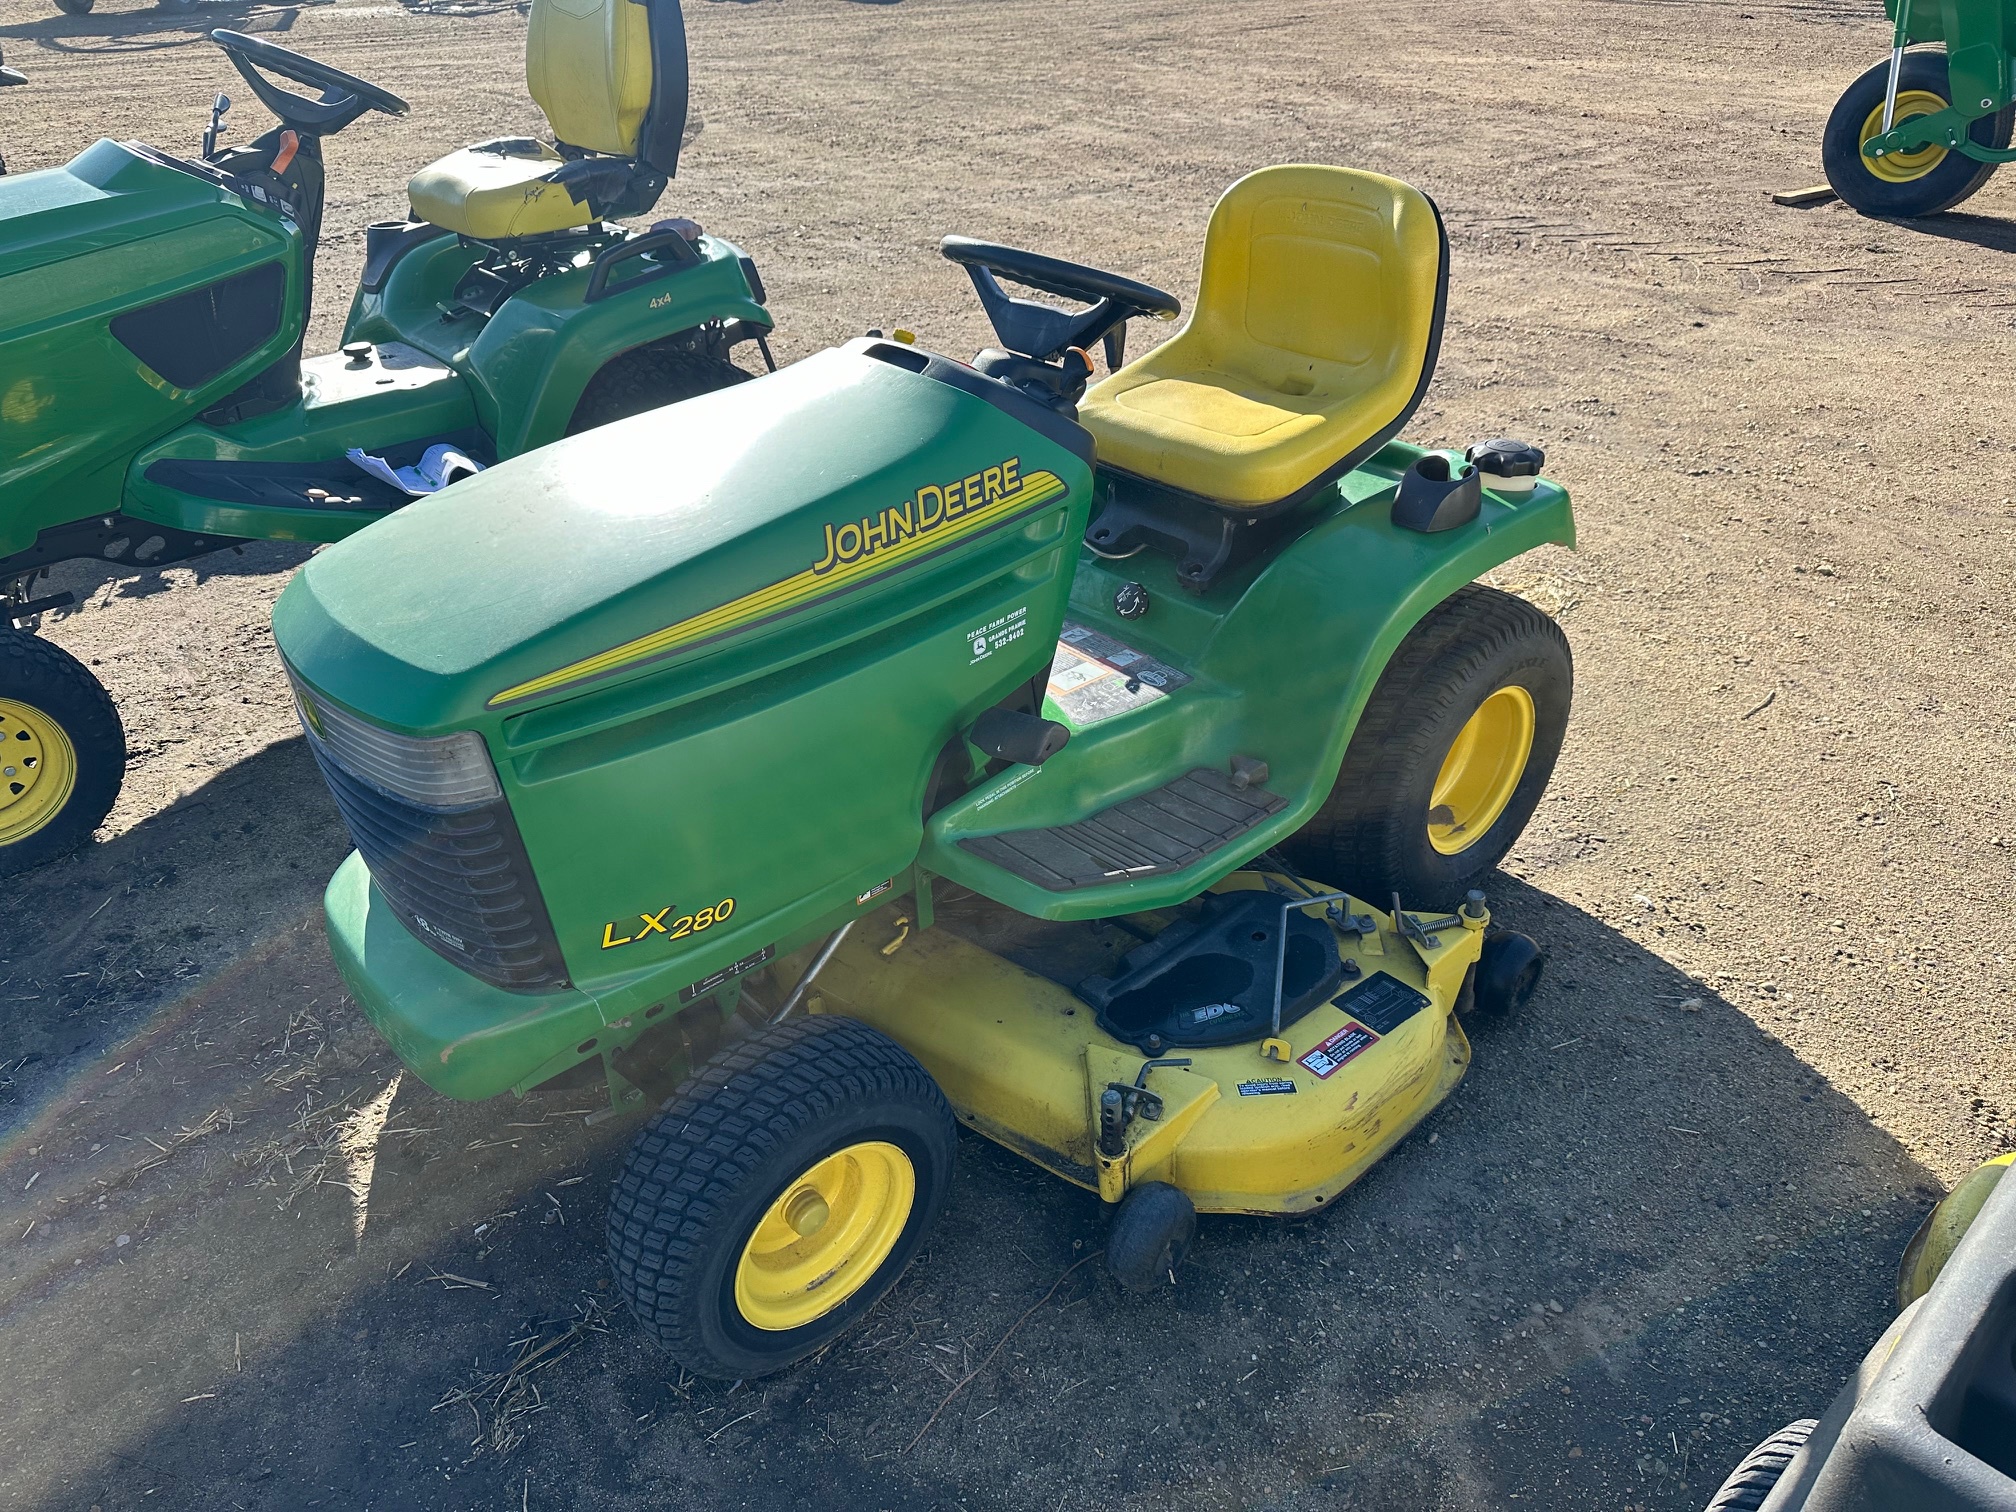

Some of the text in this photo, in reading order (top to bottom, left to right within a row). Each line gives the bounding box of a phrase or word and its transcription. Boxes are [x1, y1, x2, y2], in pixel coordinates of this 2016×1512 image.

[650, 292, 671, 309] 4x4
[813, 455, 1023, 576] JOHN DEERE
[967, 607, 1026, 639] PEACE FARM POWER
[1329, 1028, 1349, 1044] DANGER
